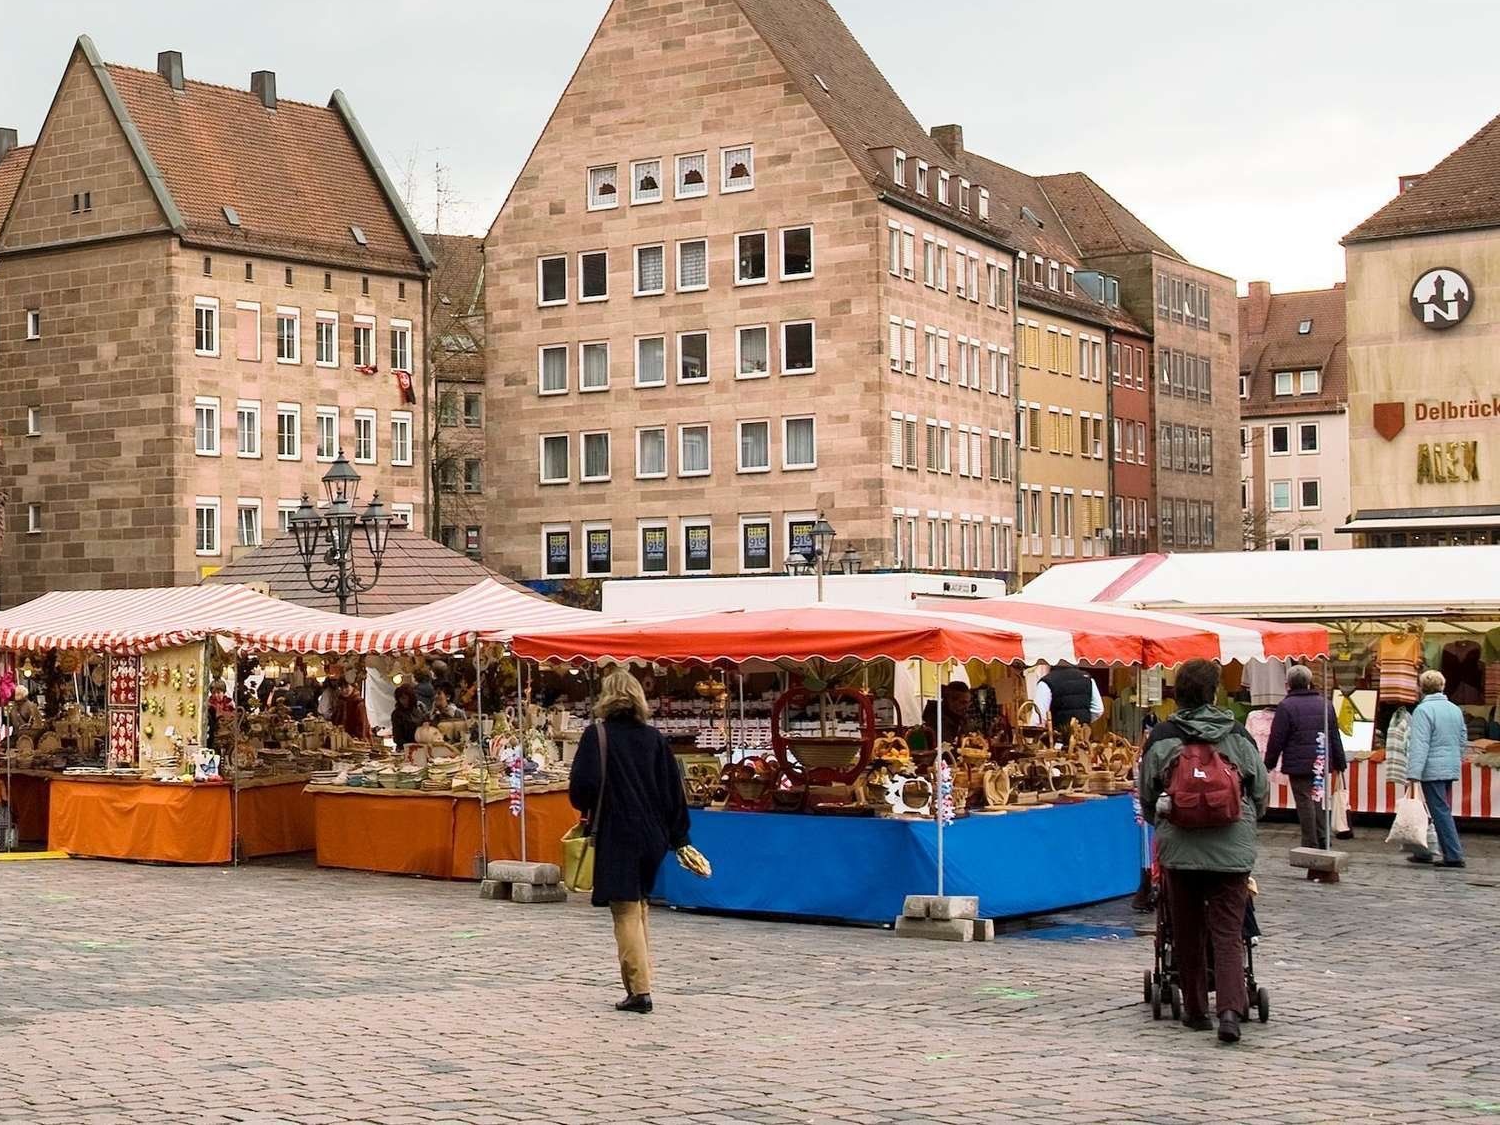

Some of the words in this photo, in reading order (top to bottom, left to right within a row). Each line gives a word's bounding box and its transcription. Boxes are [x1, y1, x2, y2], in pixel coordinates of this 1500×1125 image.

[1424, 303, 1458, 322] N
[1415, 398, 1500, 421] Delbrück
[1417, 441, 1479, 485] ALEX
